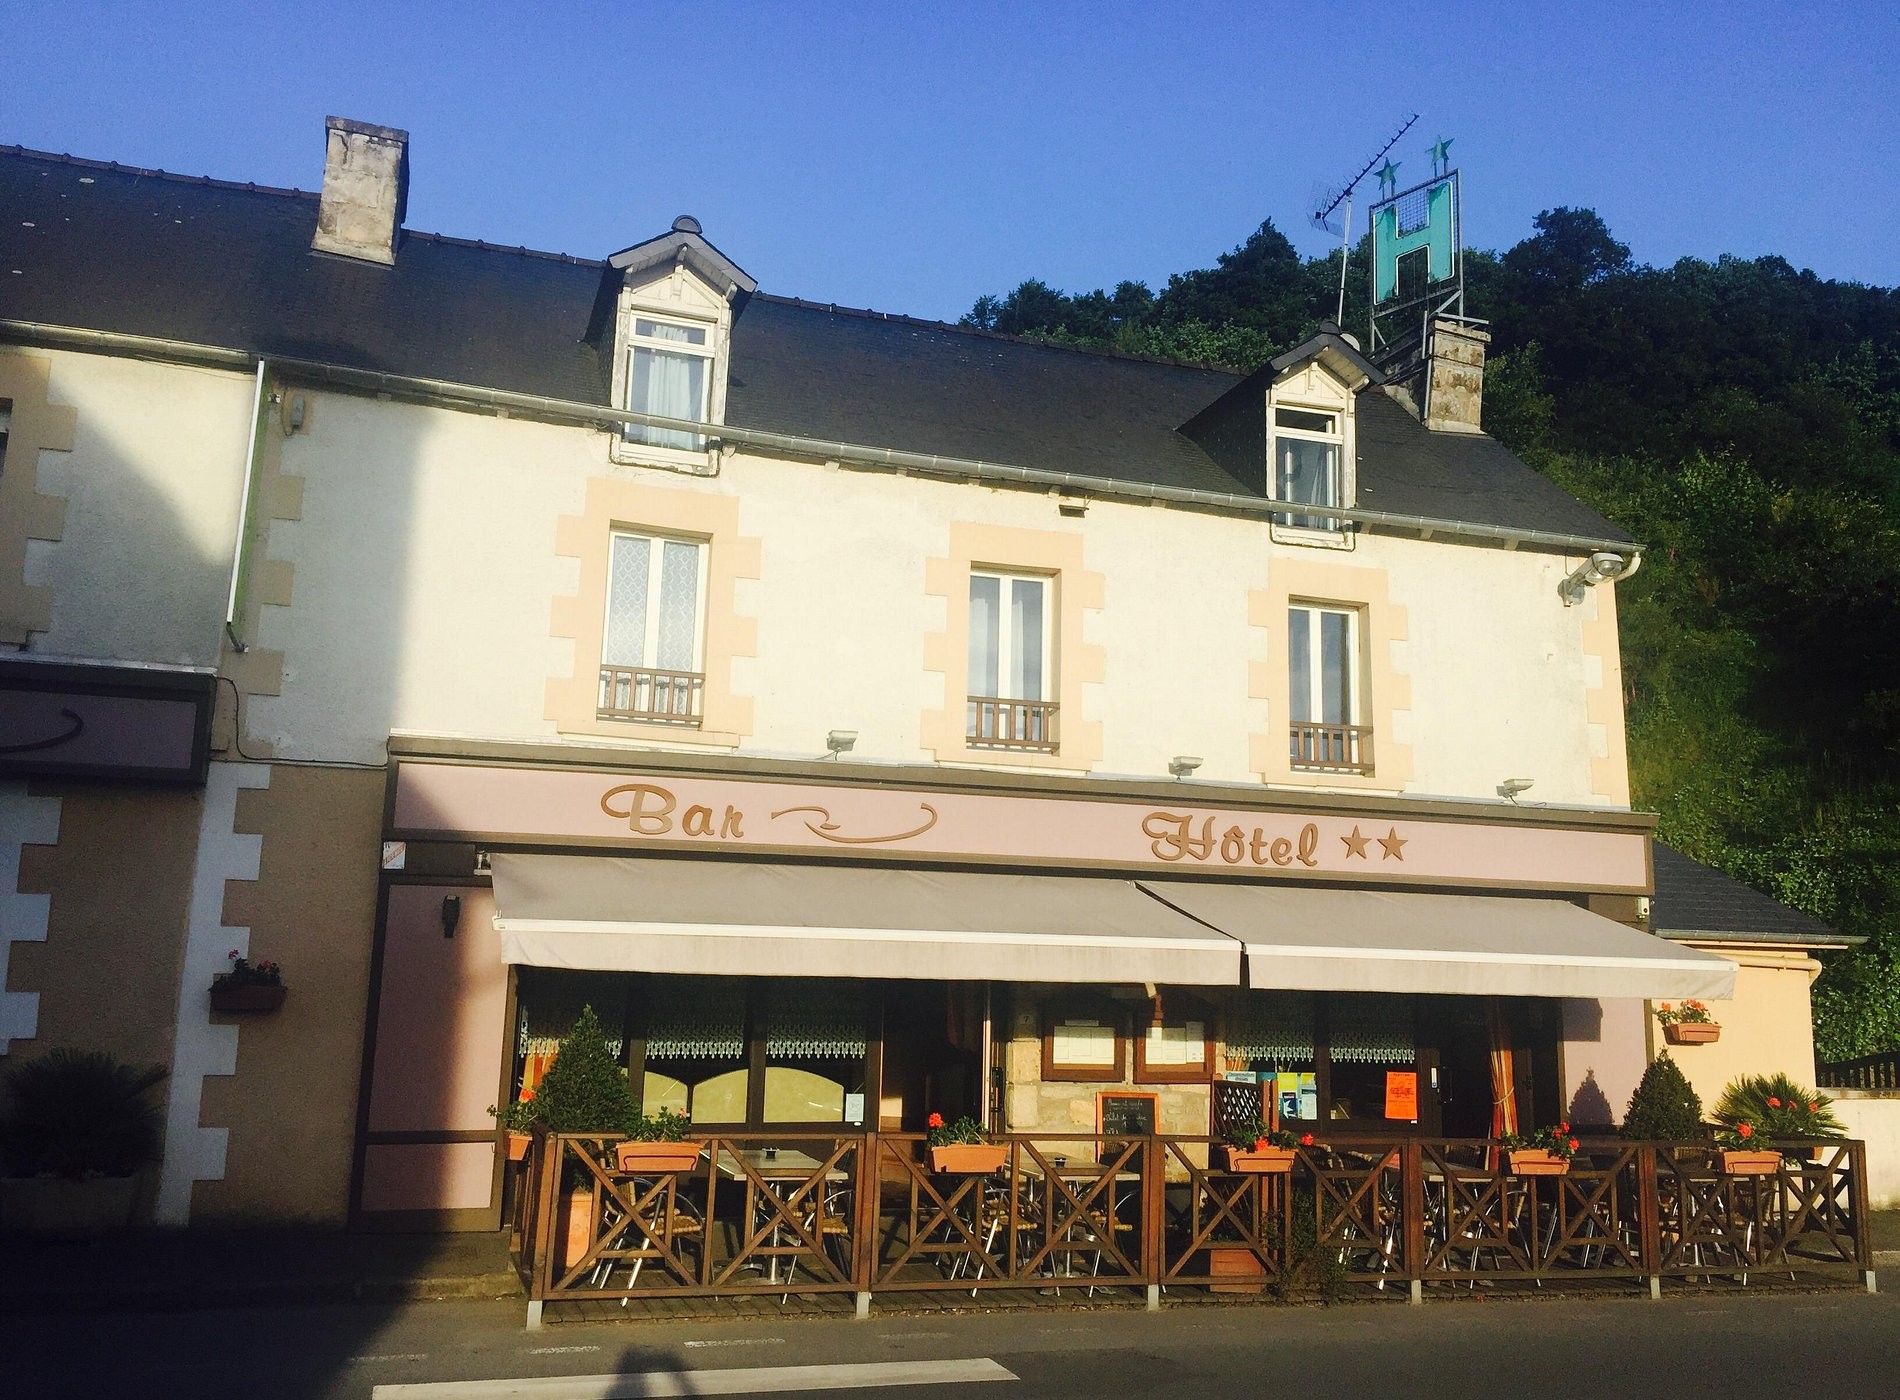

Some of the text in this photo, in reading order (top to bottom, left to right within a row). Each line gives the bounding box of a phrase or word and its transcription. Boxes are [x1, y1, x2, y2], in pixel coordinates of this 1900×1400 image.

[1373, 180, 1455, 306] H
[600, 783, 1319, 867] Bar Hôtel
